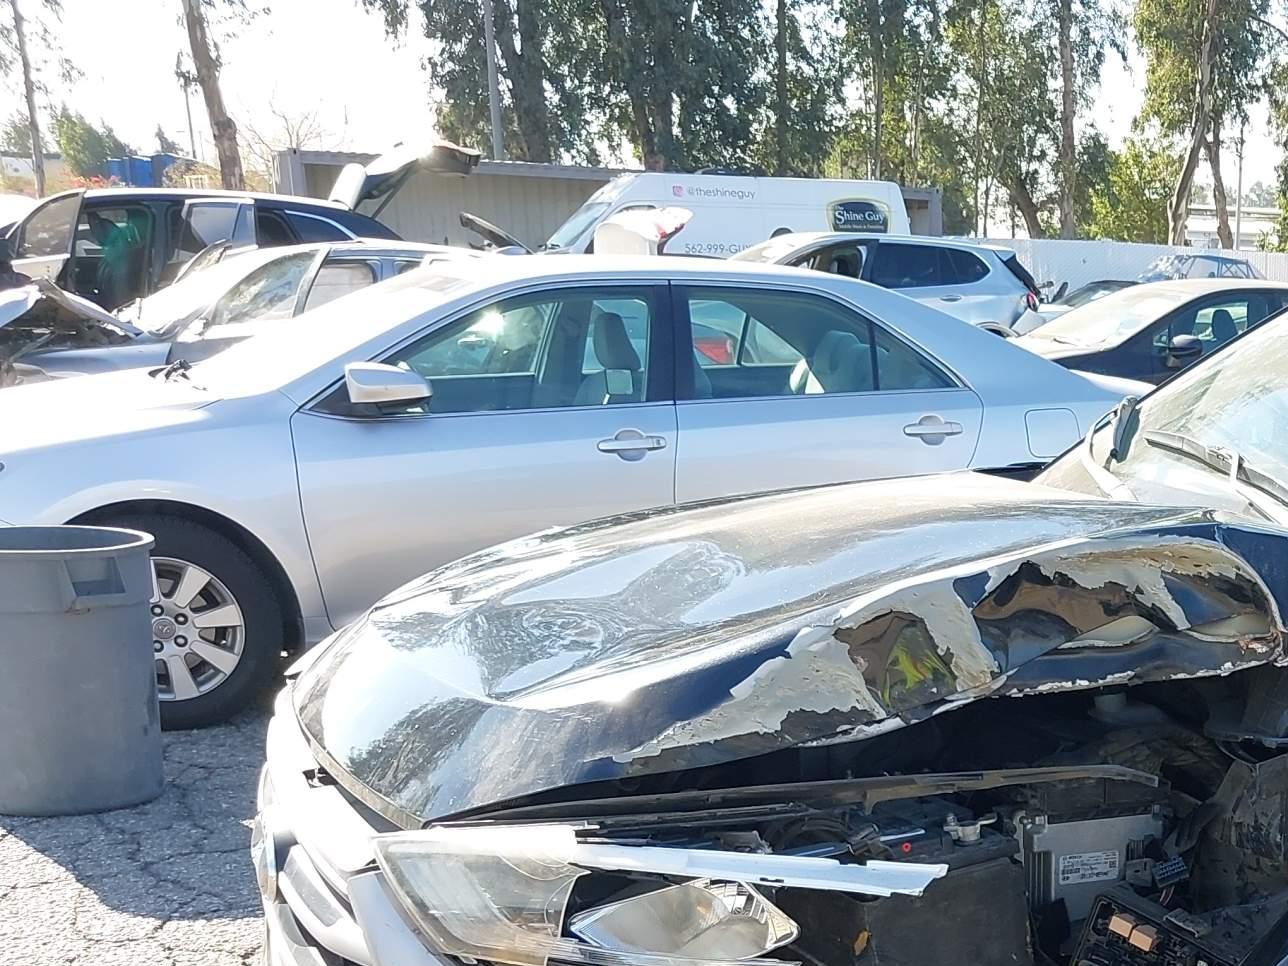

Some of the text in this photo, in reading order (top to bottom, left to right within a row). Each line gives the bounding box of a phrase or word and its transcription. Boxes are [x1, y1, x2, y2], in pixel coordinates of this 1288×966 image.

[687, 185, 756, 200] @theshineguy
[835, 210, 885, 224] Shine Guy
